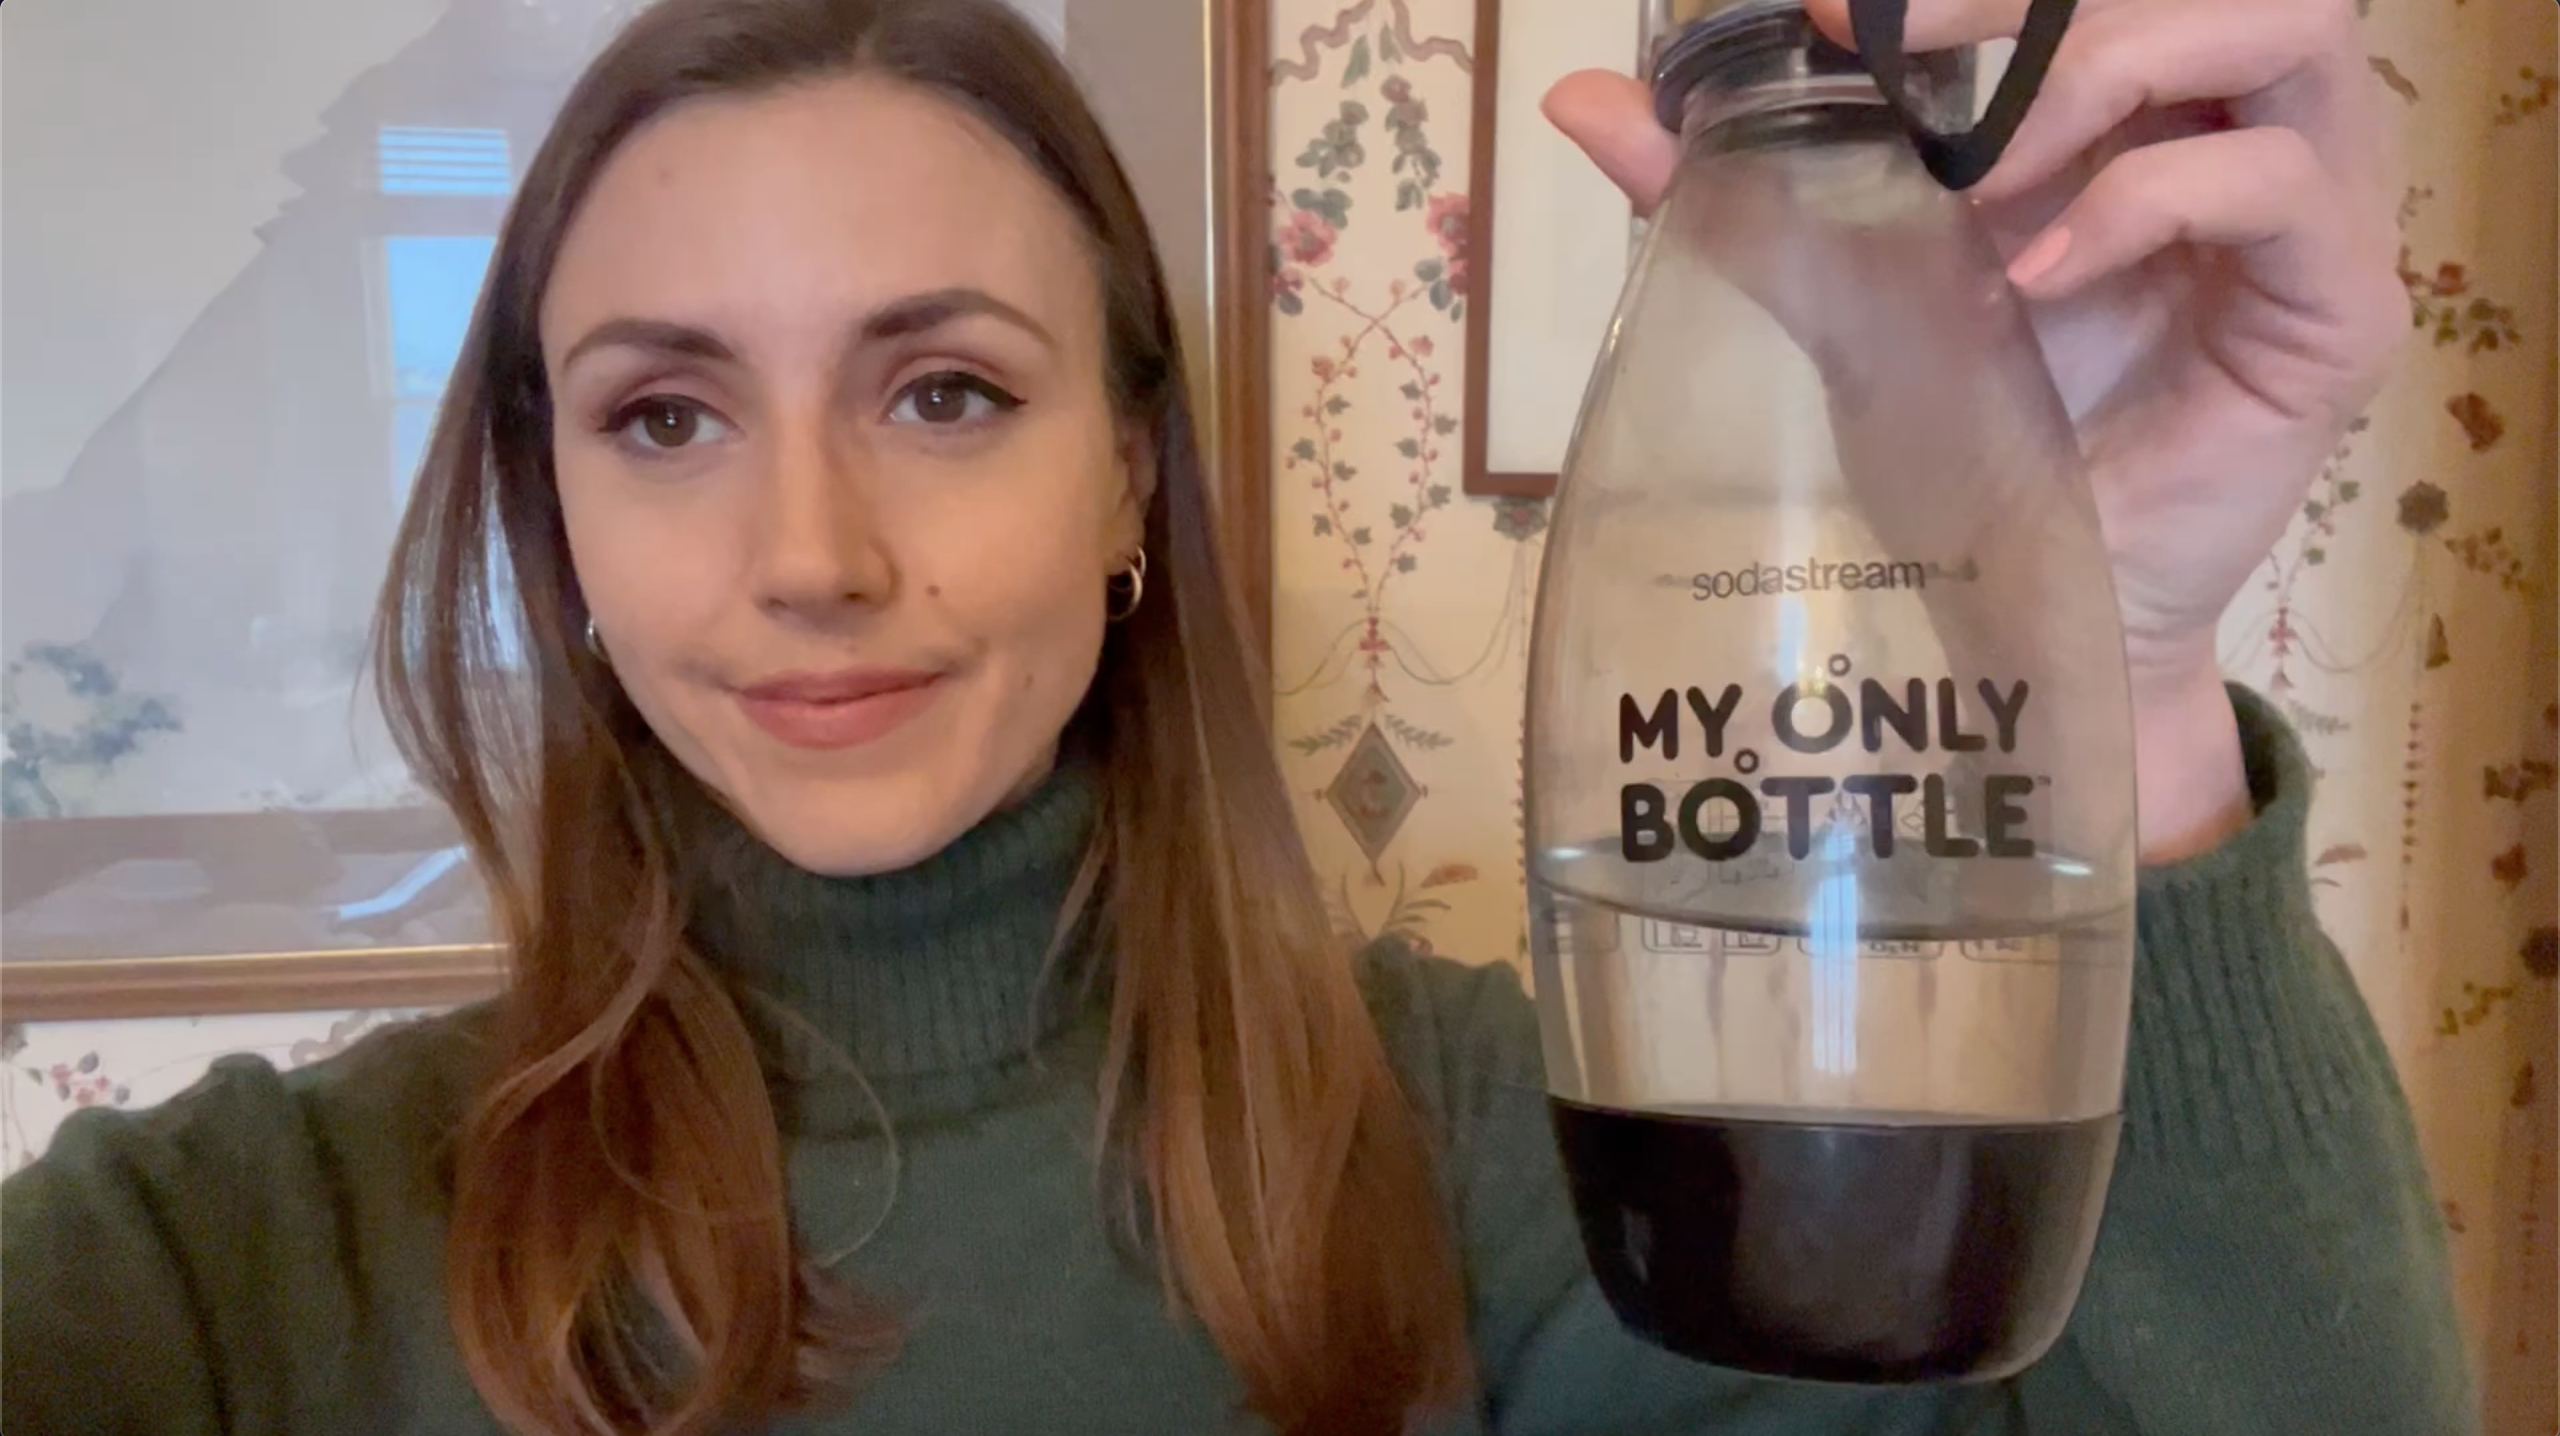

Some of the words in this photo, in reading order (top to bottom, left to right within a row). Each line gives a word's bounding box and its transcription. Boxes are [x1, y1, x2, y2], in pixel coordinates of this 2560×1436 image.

[1692, 556, 1927, 601] sodastream
[1619, 683, 1743, 763] MY
[1771, 676, 2030, 754] ONLY
[1620, 773, 2036, 864] BOTTLE
